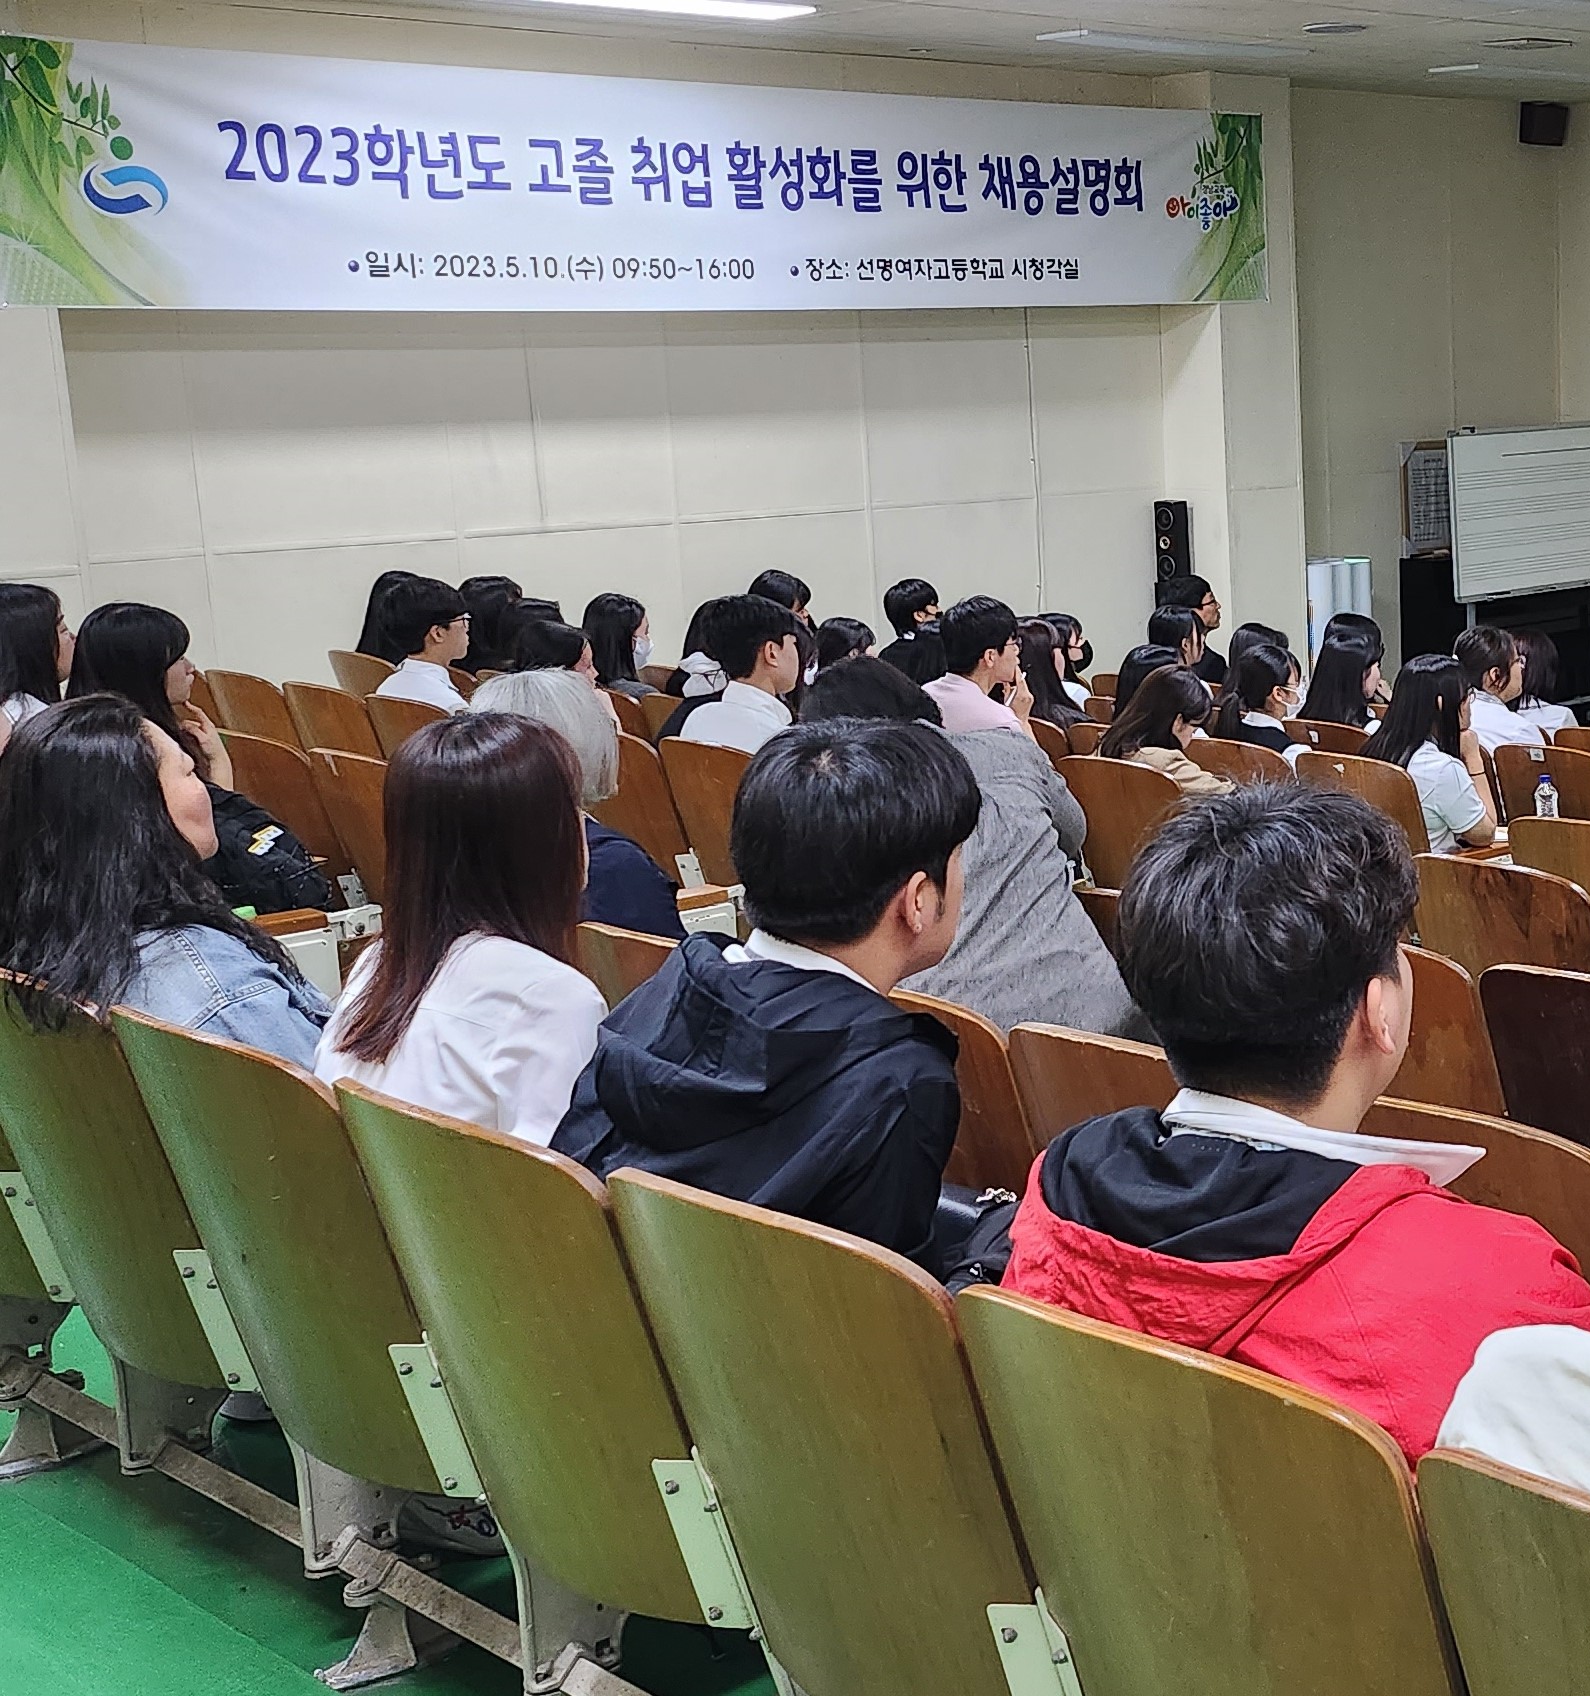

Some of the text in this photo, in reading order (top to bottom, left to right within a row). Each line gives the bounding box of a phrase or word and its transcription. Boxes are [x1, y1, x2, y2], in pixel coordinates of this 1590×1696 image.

[217, 119, 1144, 217] 2023학년도 고졸 취업 활성화를 위한 채용설명회
[1166, 195, 1239, 231] 아이좋아
[364, 250, 425, 279] 일시:
[612, 256, 756, 281] 09:50~16:00
[804, 256, 850, 282] 장소:
[856, 256, 1005, 282] 선명여자고등학교
[1010, 256, 1080, 281] 시청각실
